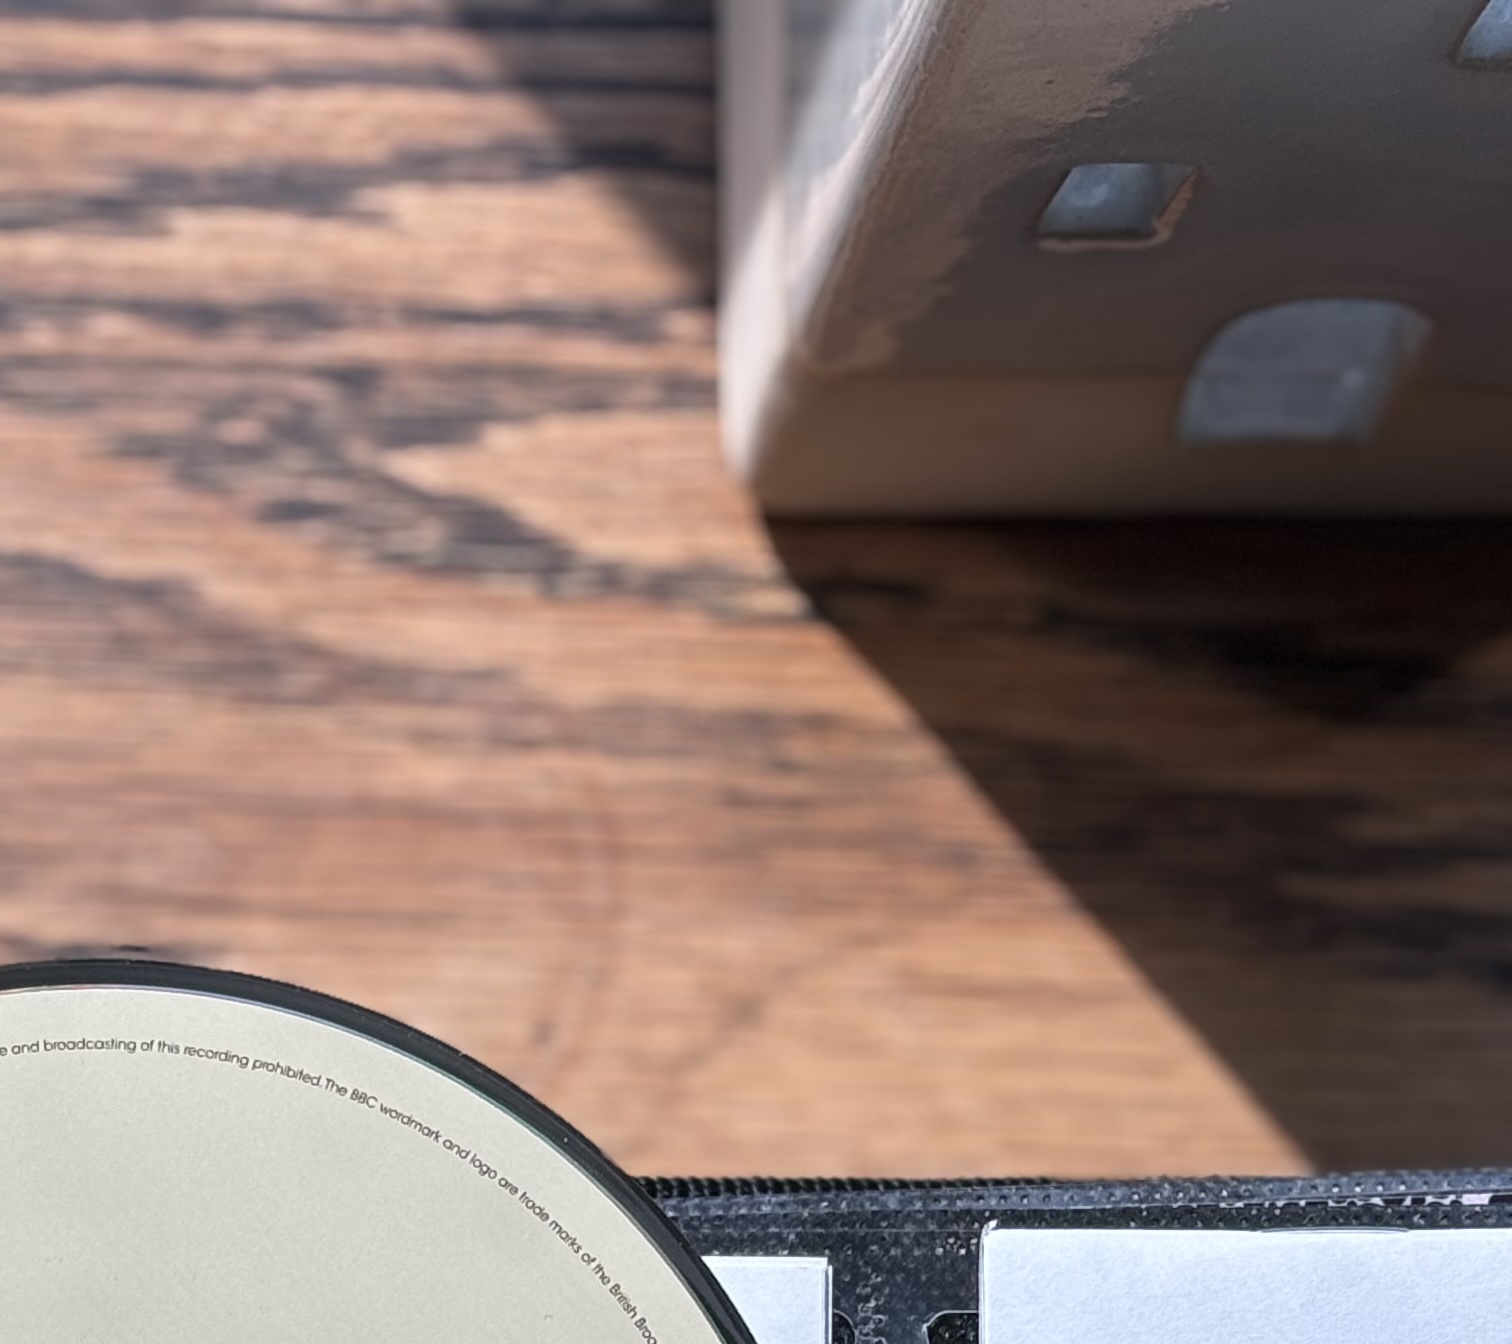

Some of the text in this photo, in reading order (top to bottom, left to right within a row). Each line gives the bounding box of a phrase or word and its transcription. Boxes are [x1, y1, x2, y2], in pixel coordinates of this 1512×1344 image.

[10, 1039, 40, 1056] and
[42, 1037, 137, 1055] broadcasting
[139, 1039, 155, 1052] of
[157, 1039, 181, 1055] this
[182, 1045, 250, 1070] recording
[324, 1077, 349, 1097] The
[349, 1087, 379, 1109] BBC
[379, 1102, 443, 1144] wordmark
[442, 1138, 472, 1160] and
[468, 1152, 498, 1180] logo
[497, 1176, 519, 1196] are
[518, 1190, 550, 1223] trade
[548, 1219, 583, 1255] marks
[580, 1252, 598, 1267] of
[591, 1262, 612, 1286] the
[608, 1282, 638, 1320] British
